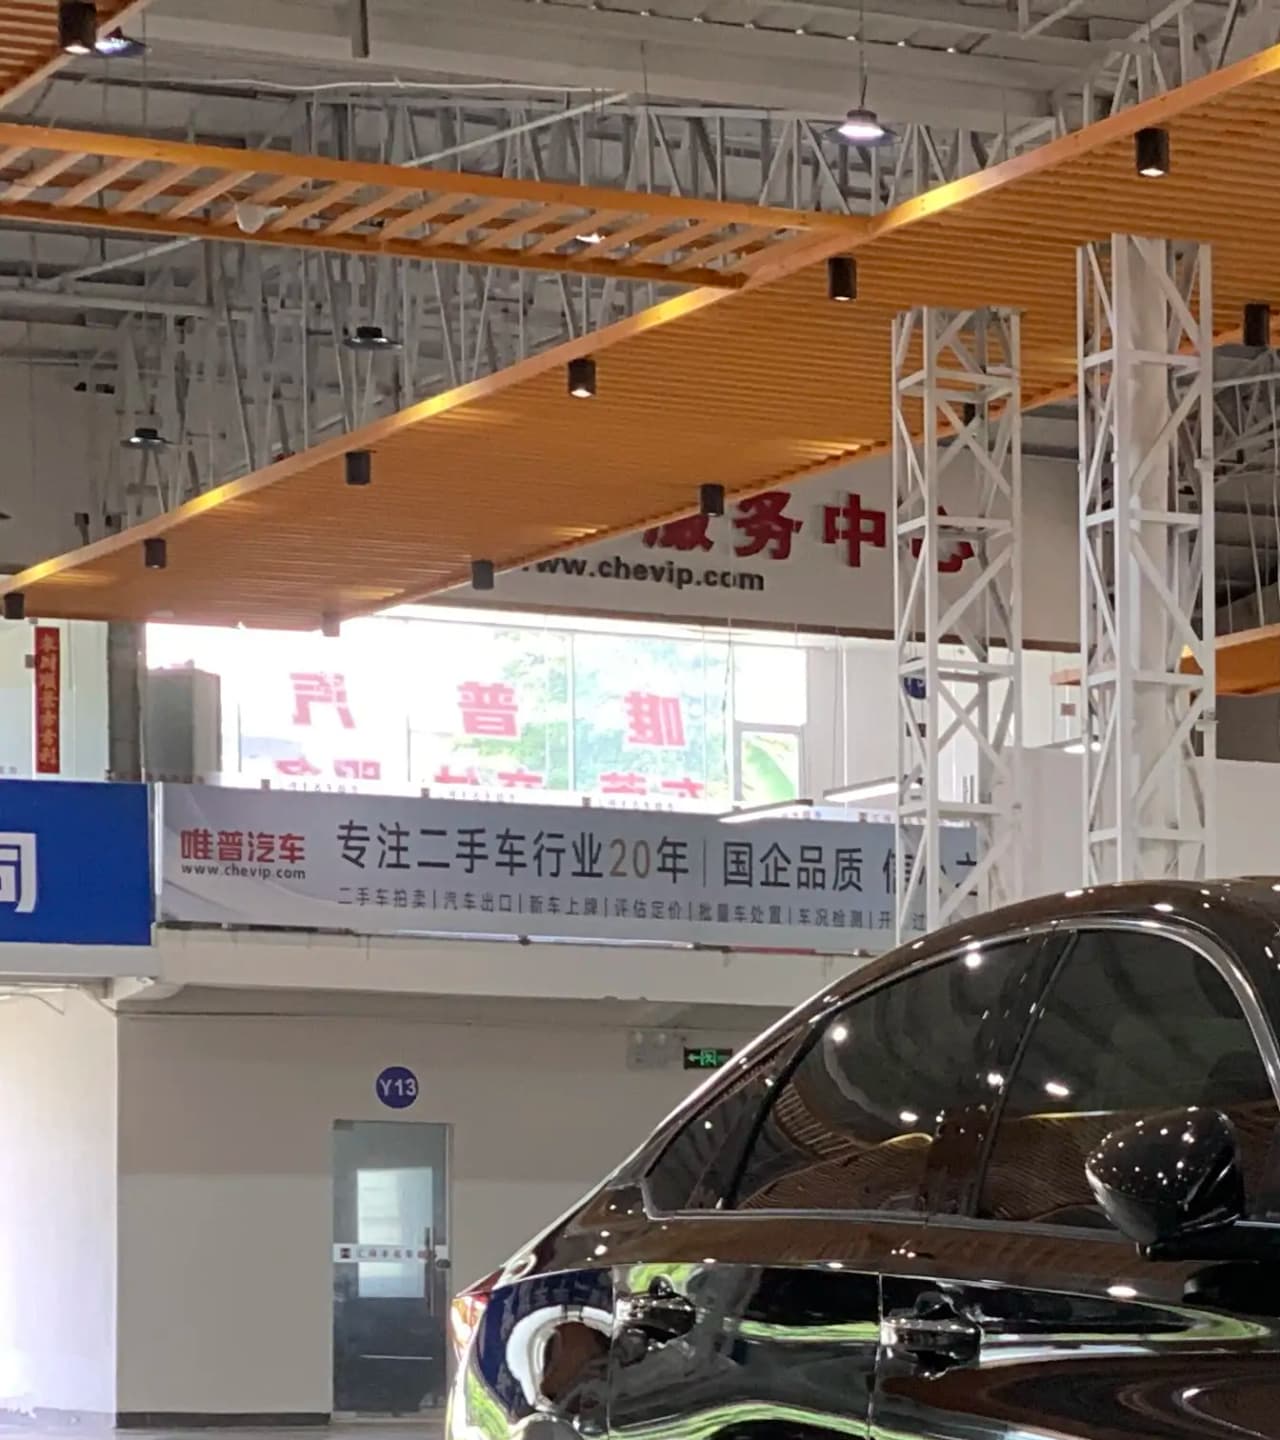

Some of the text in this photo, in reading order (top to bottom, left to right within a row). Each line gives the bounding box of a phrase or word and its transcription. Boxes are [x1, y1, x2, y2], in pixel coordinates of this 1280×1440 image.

[180, 828, 305, 865] 唯普汽车
[181, 862, 306, 881] www.chevip.com
[380, 1077, 417, 1097] Y13
